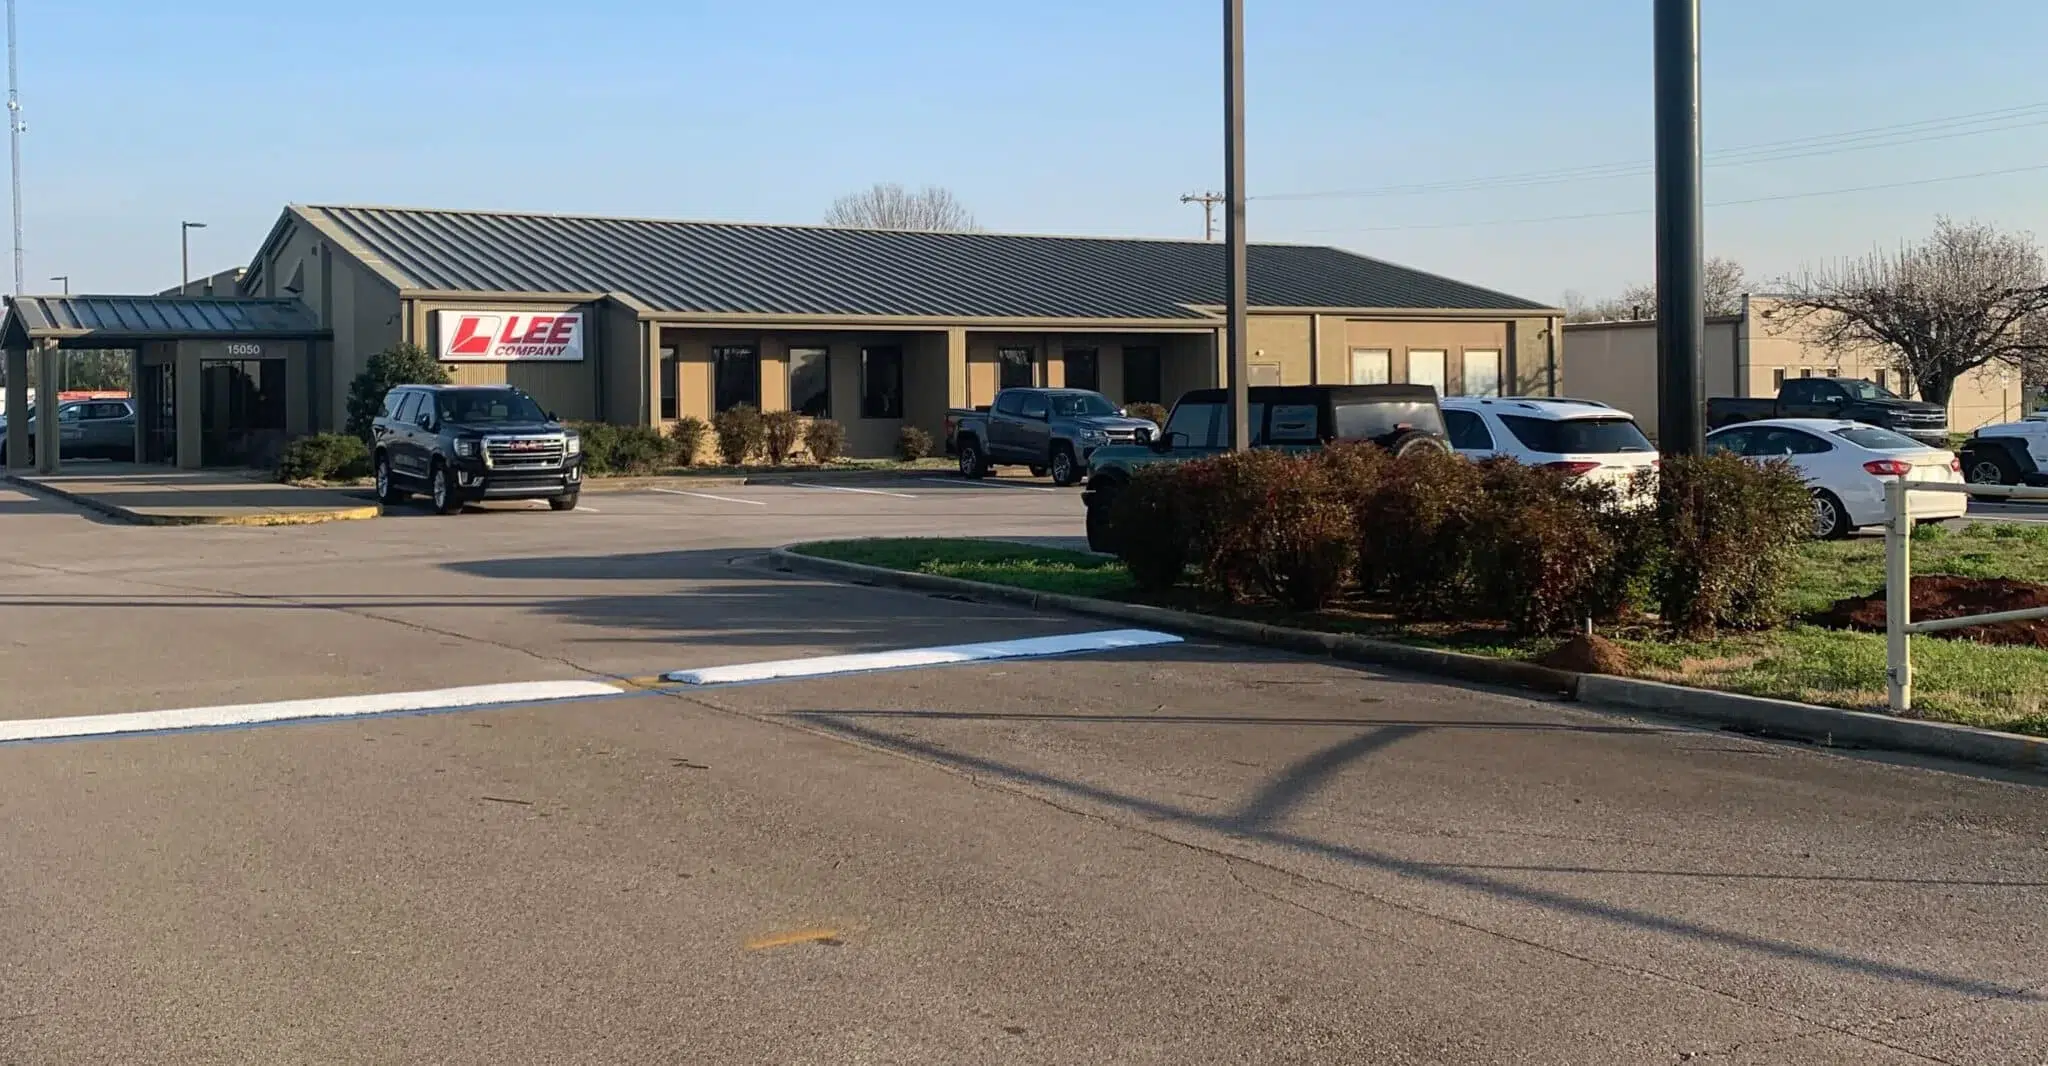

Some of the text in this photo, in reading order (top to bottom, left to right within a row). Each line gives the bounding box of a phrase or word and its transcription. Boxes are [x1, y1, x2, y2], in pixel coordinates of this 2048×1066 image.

[499, 316, 578, 344] LEE
[227, 344, 261, 355] 15050
[494, 346, 567, 356] COMPANY
